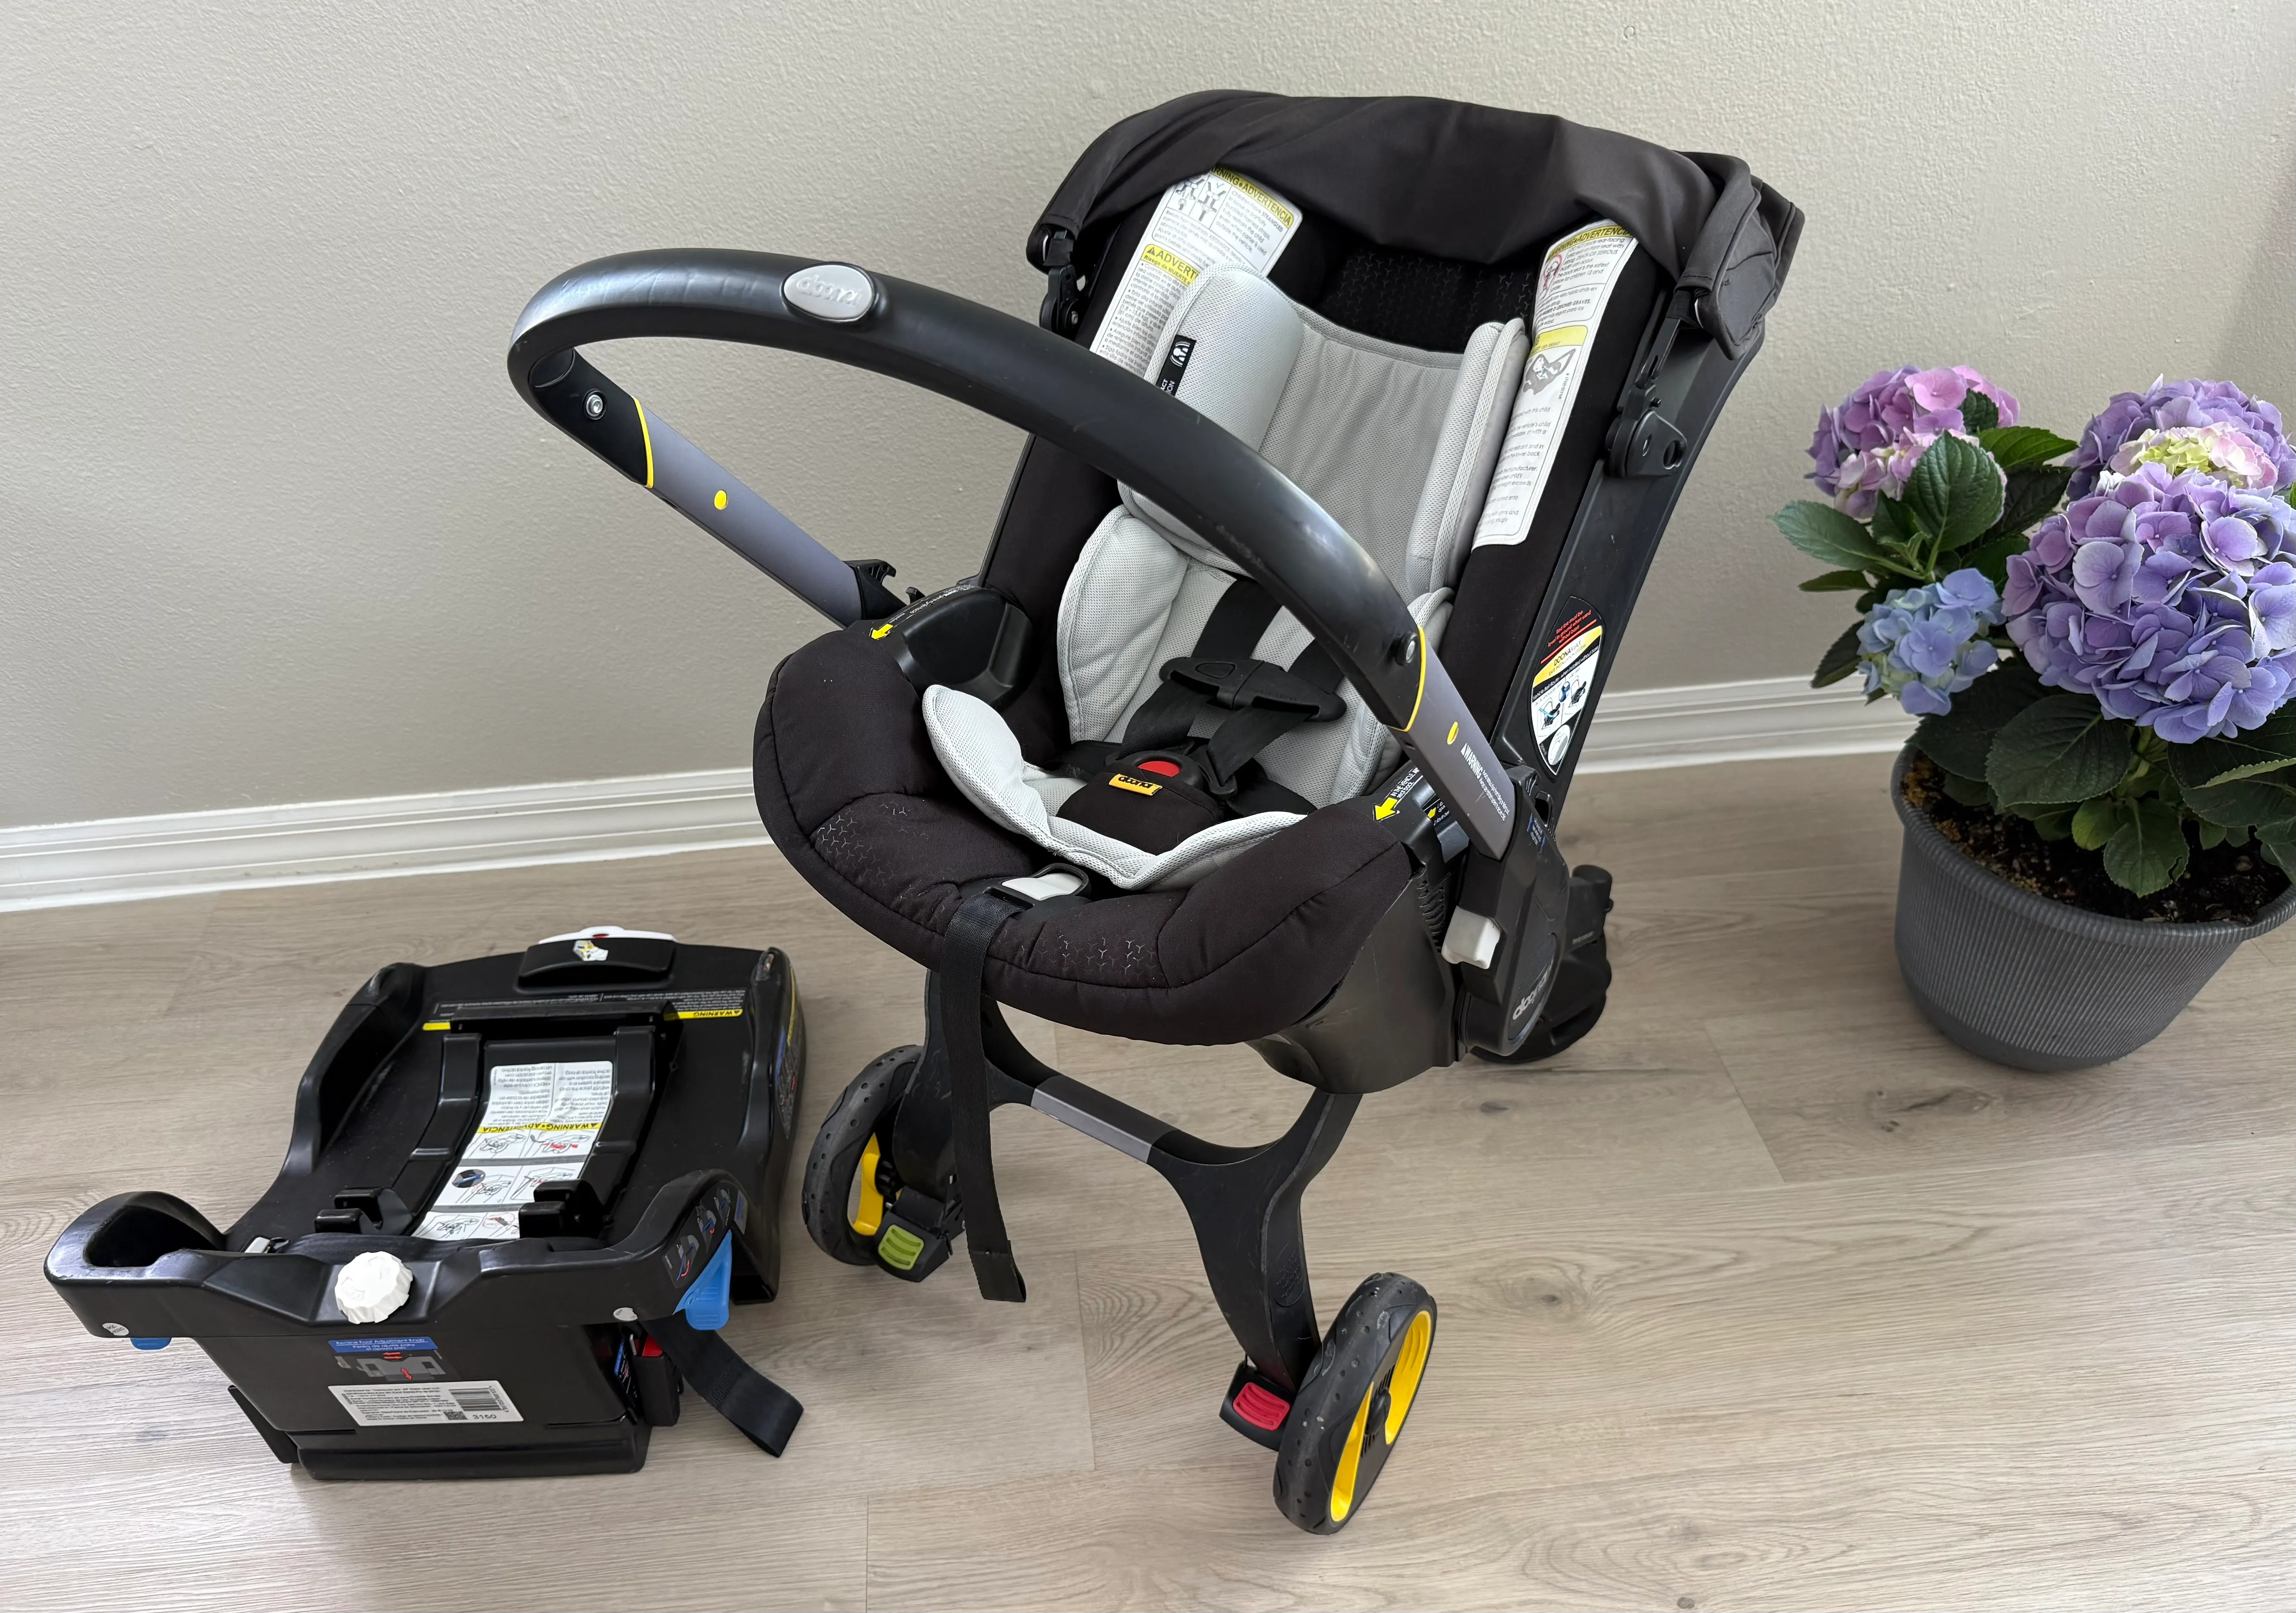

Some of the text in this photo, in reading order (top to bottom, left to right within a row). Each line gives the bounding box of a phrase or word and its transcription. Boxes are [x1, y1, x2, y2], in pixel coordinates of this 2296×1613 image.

[1212, 165, 1293, 225] ARNING ADVERTENCIA
[1261, 211, 1284, 232] STRANGLED
[1167, 267, 1187, 283] MUERTE
[1465, 745, 1483, 779] WARNING
